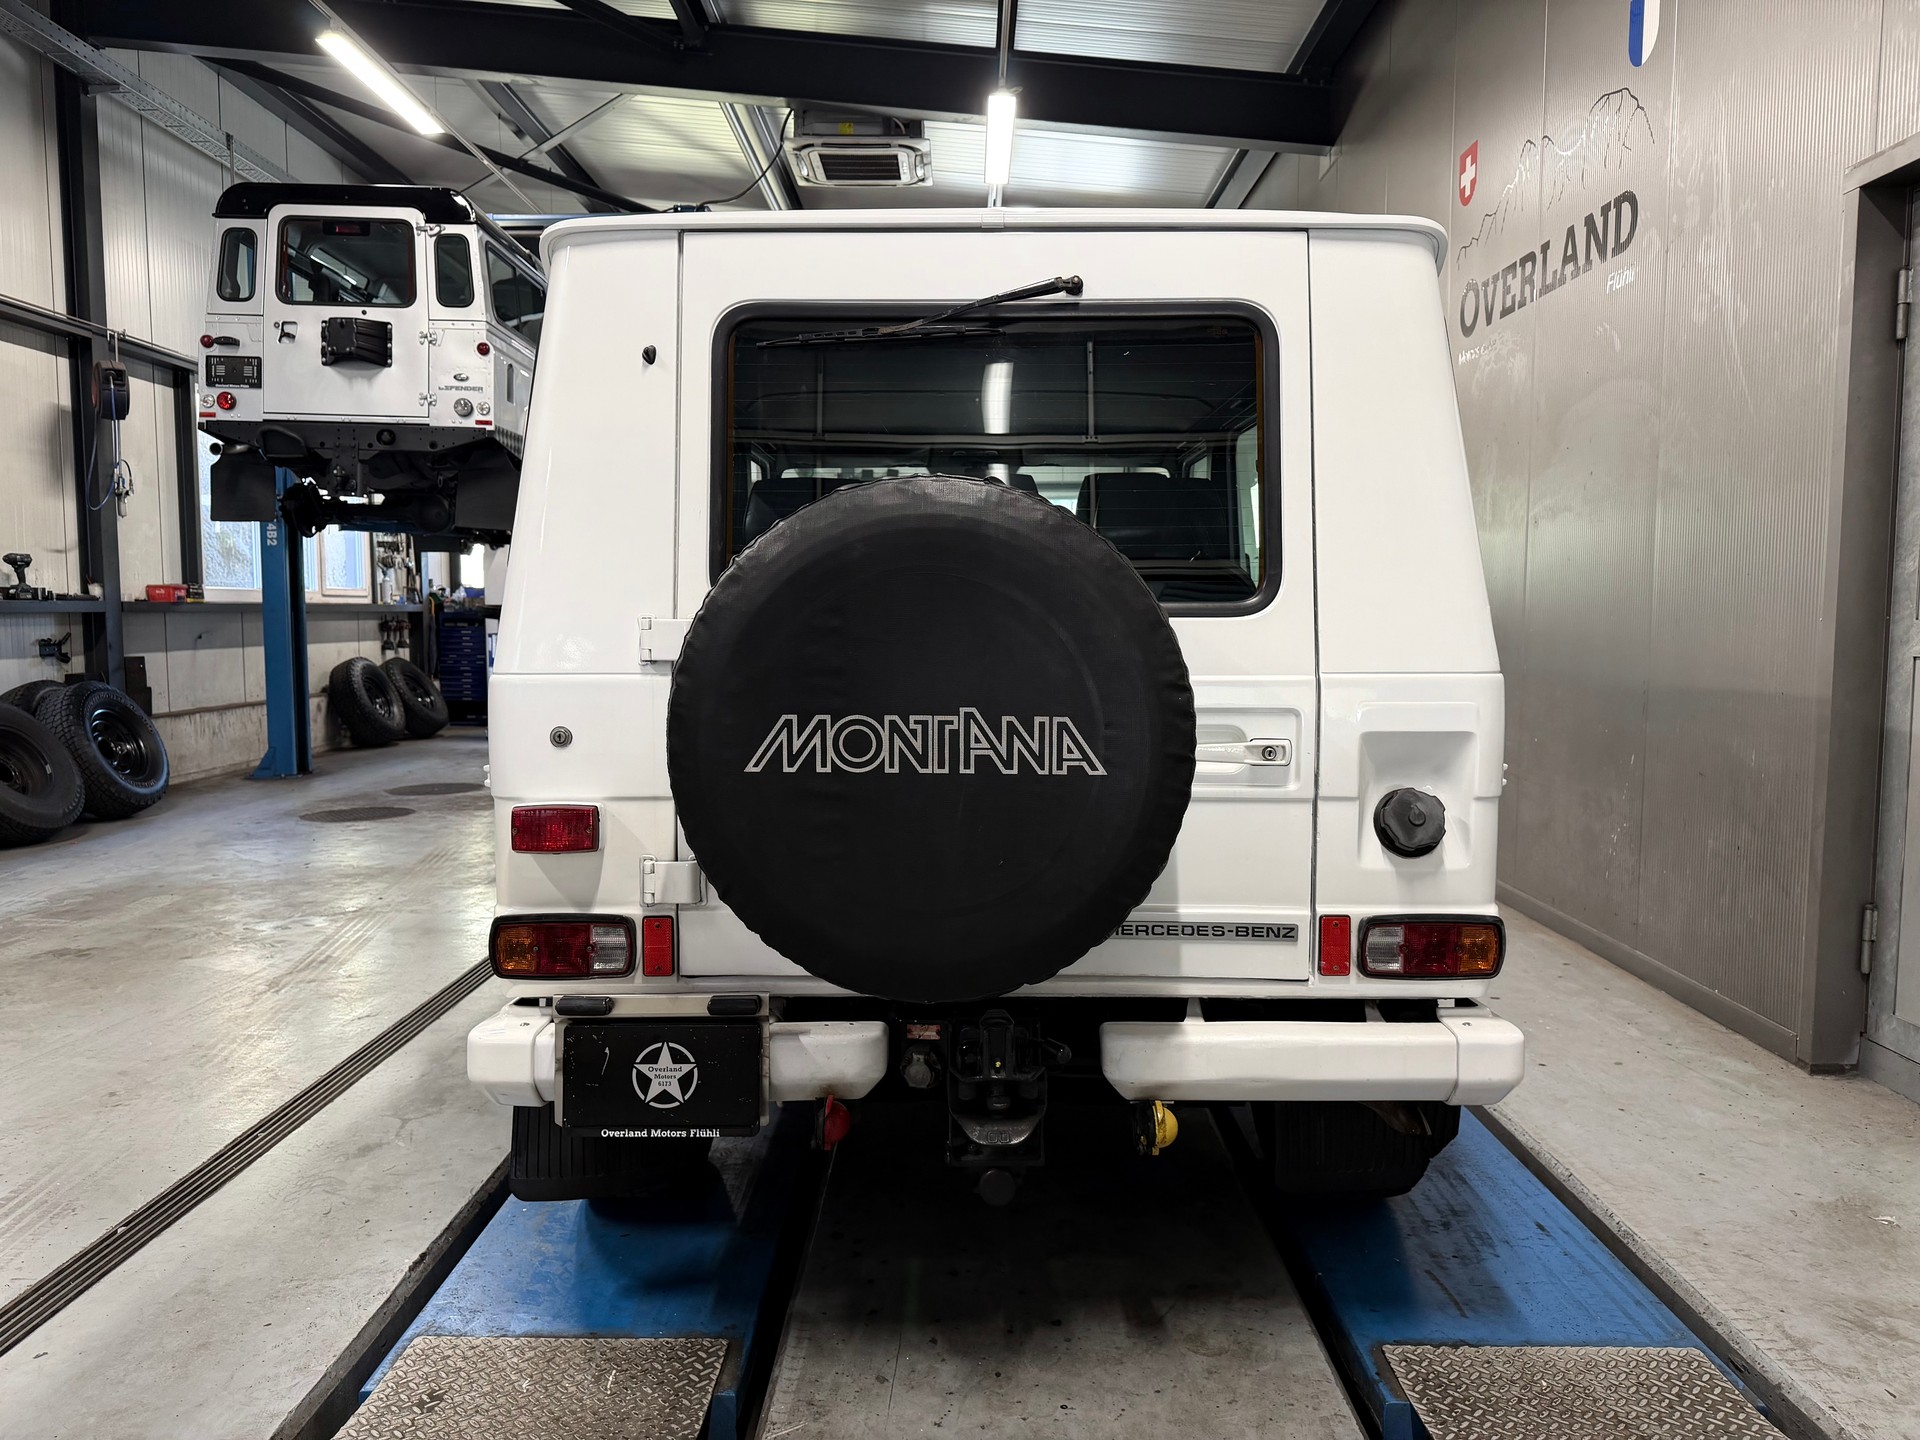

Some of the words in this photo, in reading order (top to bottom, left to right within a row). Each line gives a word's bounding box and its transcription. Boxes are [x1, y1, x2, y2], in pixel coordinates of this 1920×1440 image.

[1460, 189, 1639, 338] OVERLAND
[744, 707, 1108, 776] MONTANA
[600, 1128, 648, 1138] Overland
[650, 1128, 687, 1138] Motors
[689, 1128, 721, 1138] Flühli
